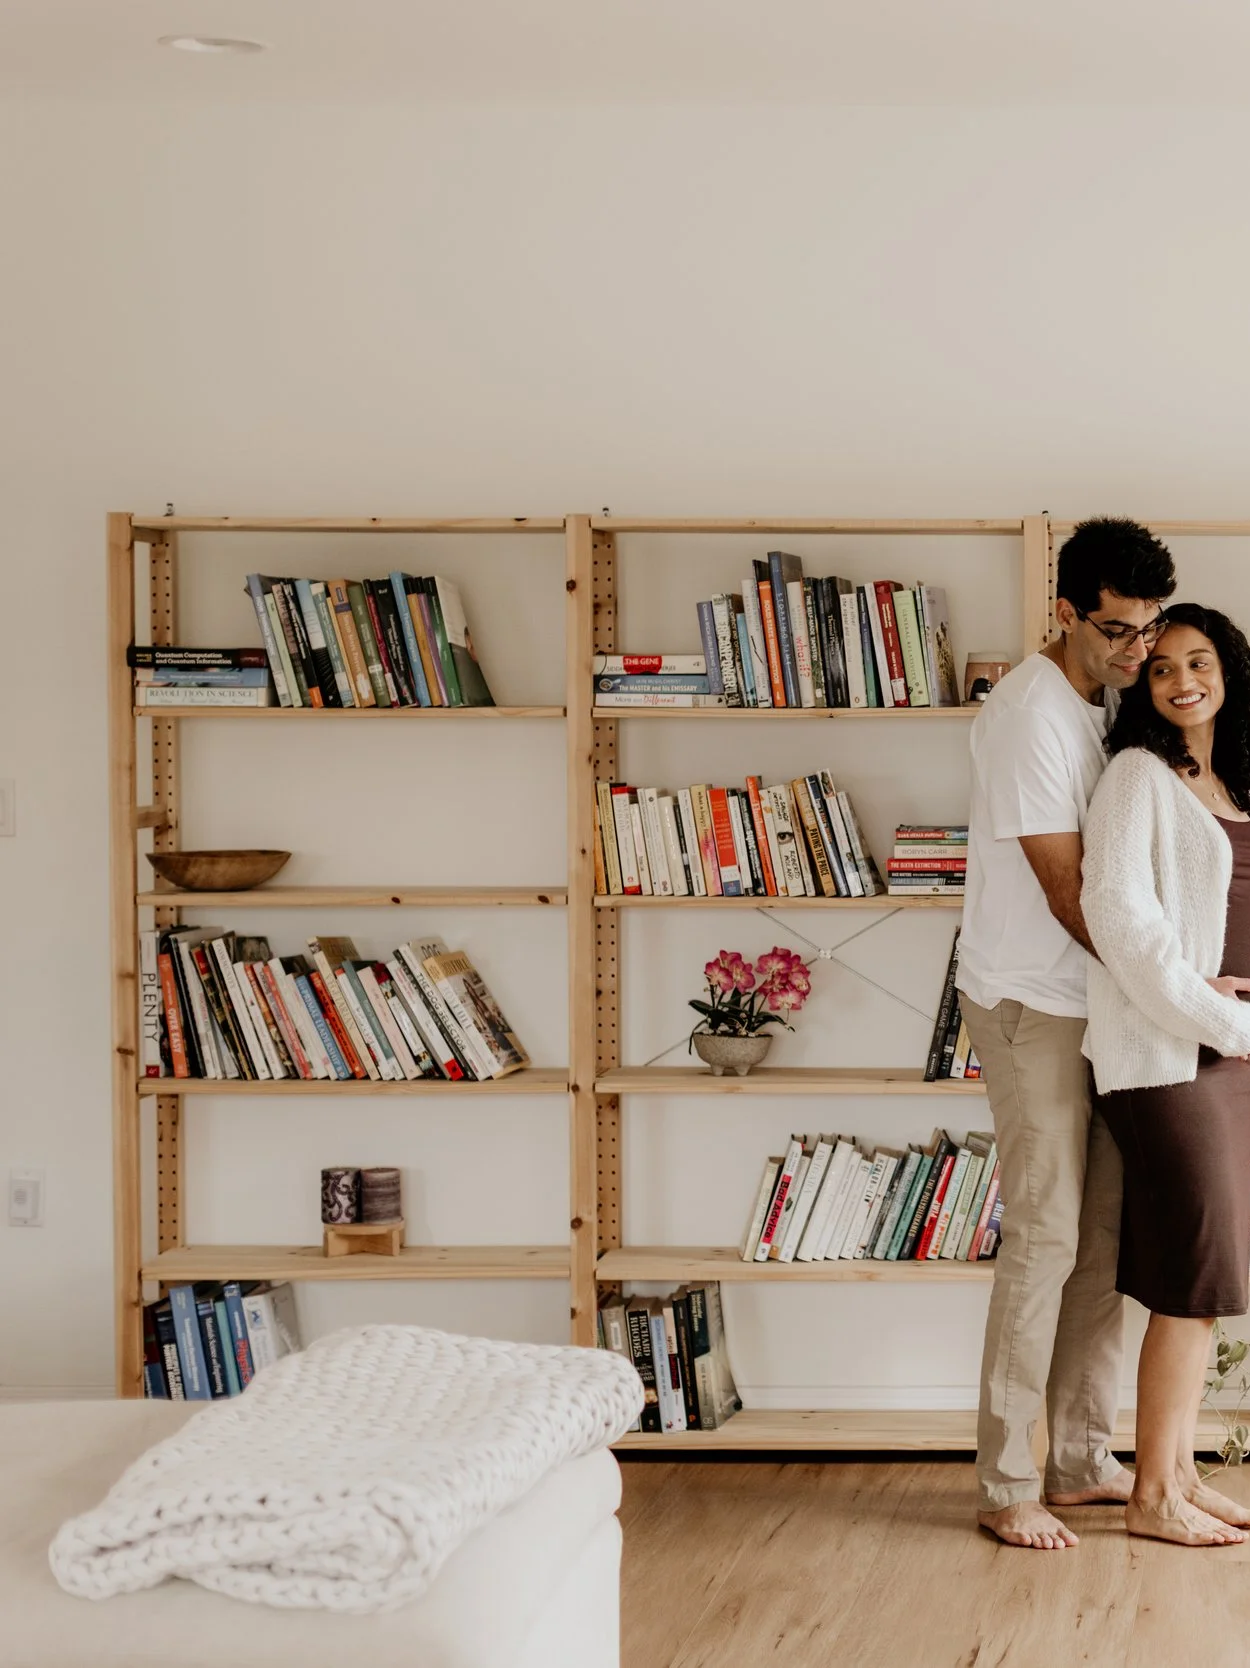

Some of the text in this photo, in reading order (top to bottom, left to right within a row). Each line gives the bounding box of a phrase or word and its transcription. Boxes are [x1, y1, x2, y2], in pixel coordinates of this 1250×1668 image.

[763, 599, 771, 618] SOLID
[766, 619, 774, 637] STATE
[776, 592, 787, 639] STOPPING
[806, 606, 815, 634] SELF-MADE
[712, 601, 738, 689] AMERICAN POWER
[795, 635, 811, 678] what if?
[810, 636, 818, 661] TAPESTRY
[901, 608, 917, 680] GENERAL RELATIVITY
[643, 695, 675, 705] Different
[698, 810, 706, 827] happy
[780, 800, 789, 822] SAVAGE
[789, 849, 800, 879] ROBERTO
[808, 827, 829, 876] PAYING THE PRICE
[142, 973, 157, 1042] PLENTY
[415, 971, 428, 988] THE
[426, 989, 442, 1010] DOG
[438, 1008, 467, 1051] SELECTOR
[938, 961, 958, 1027] THE BEAUTIFUL GAME
[167, 1007, 182, 1054] OVER EASY
[314, 1018, 340, 1065] LEADERSHIP
[925, 1178, 934, 1192] THE
[764, 1180, 789, 1239] Bad Advice
[908, 1190, 930, 1238] POLYSILOXANES
[204, 1316, 225, 1393] Materials Science Engineering
[628, 1316, 643, 1358] RHODES
[638, 1314, 652, 1356] RICHARD
[233, 1338, 254, 1383] Physics
